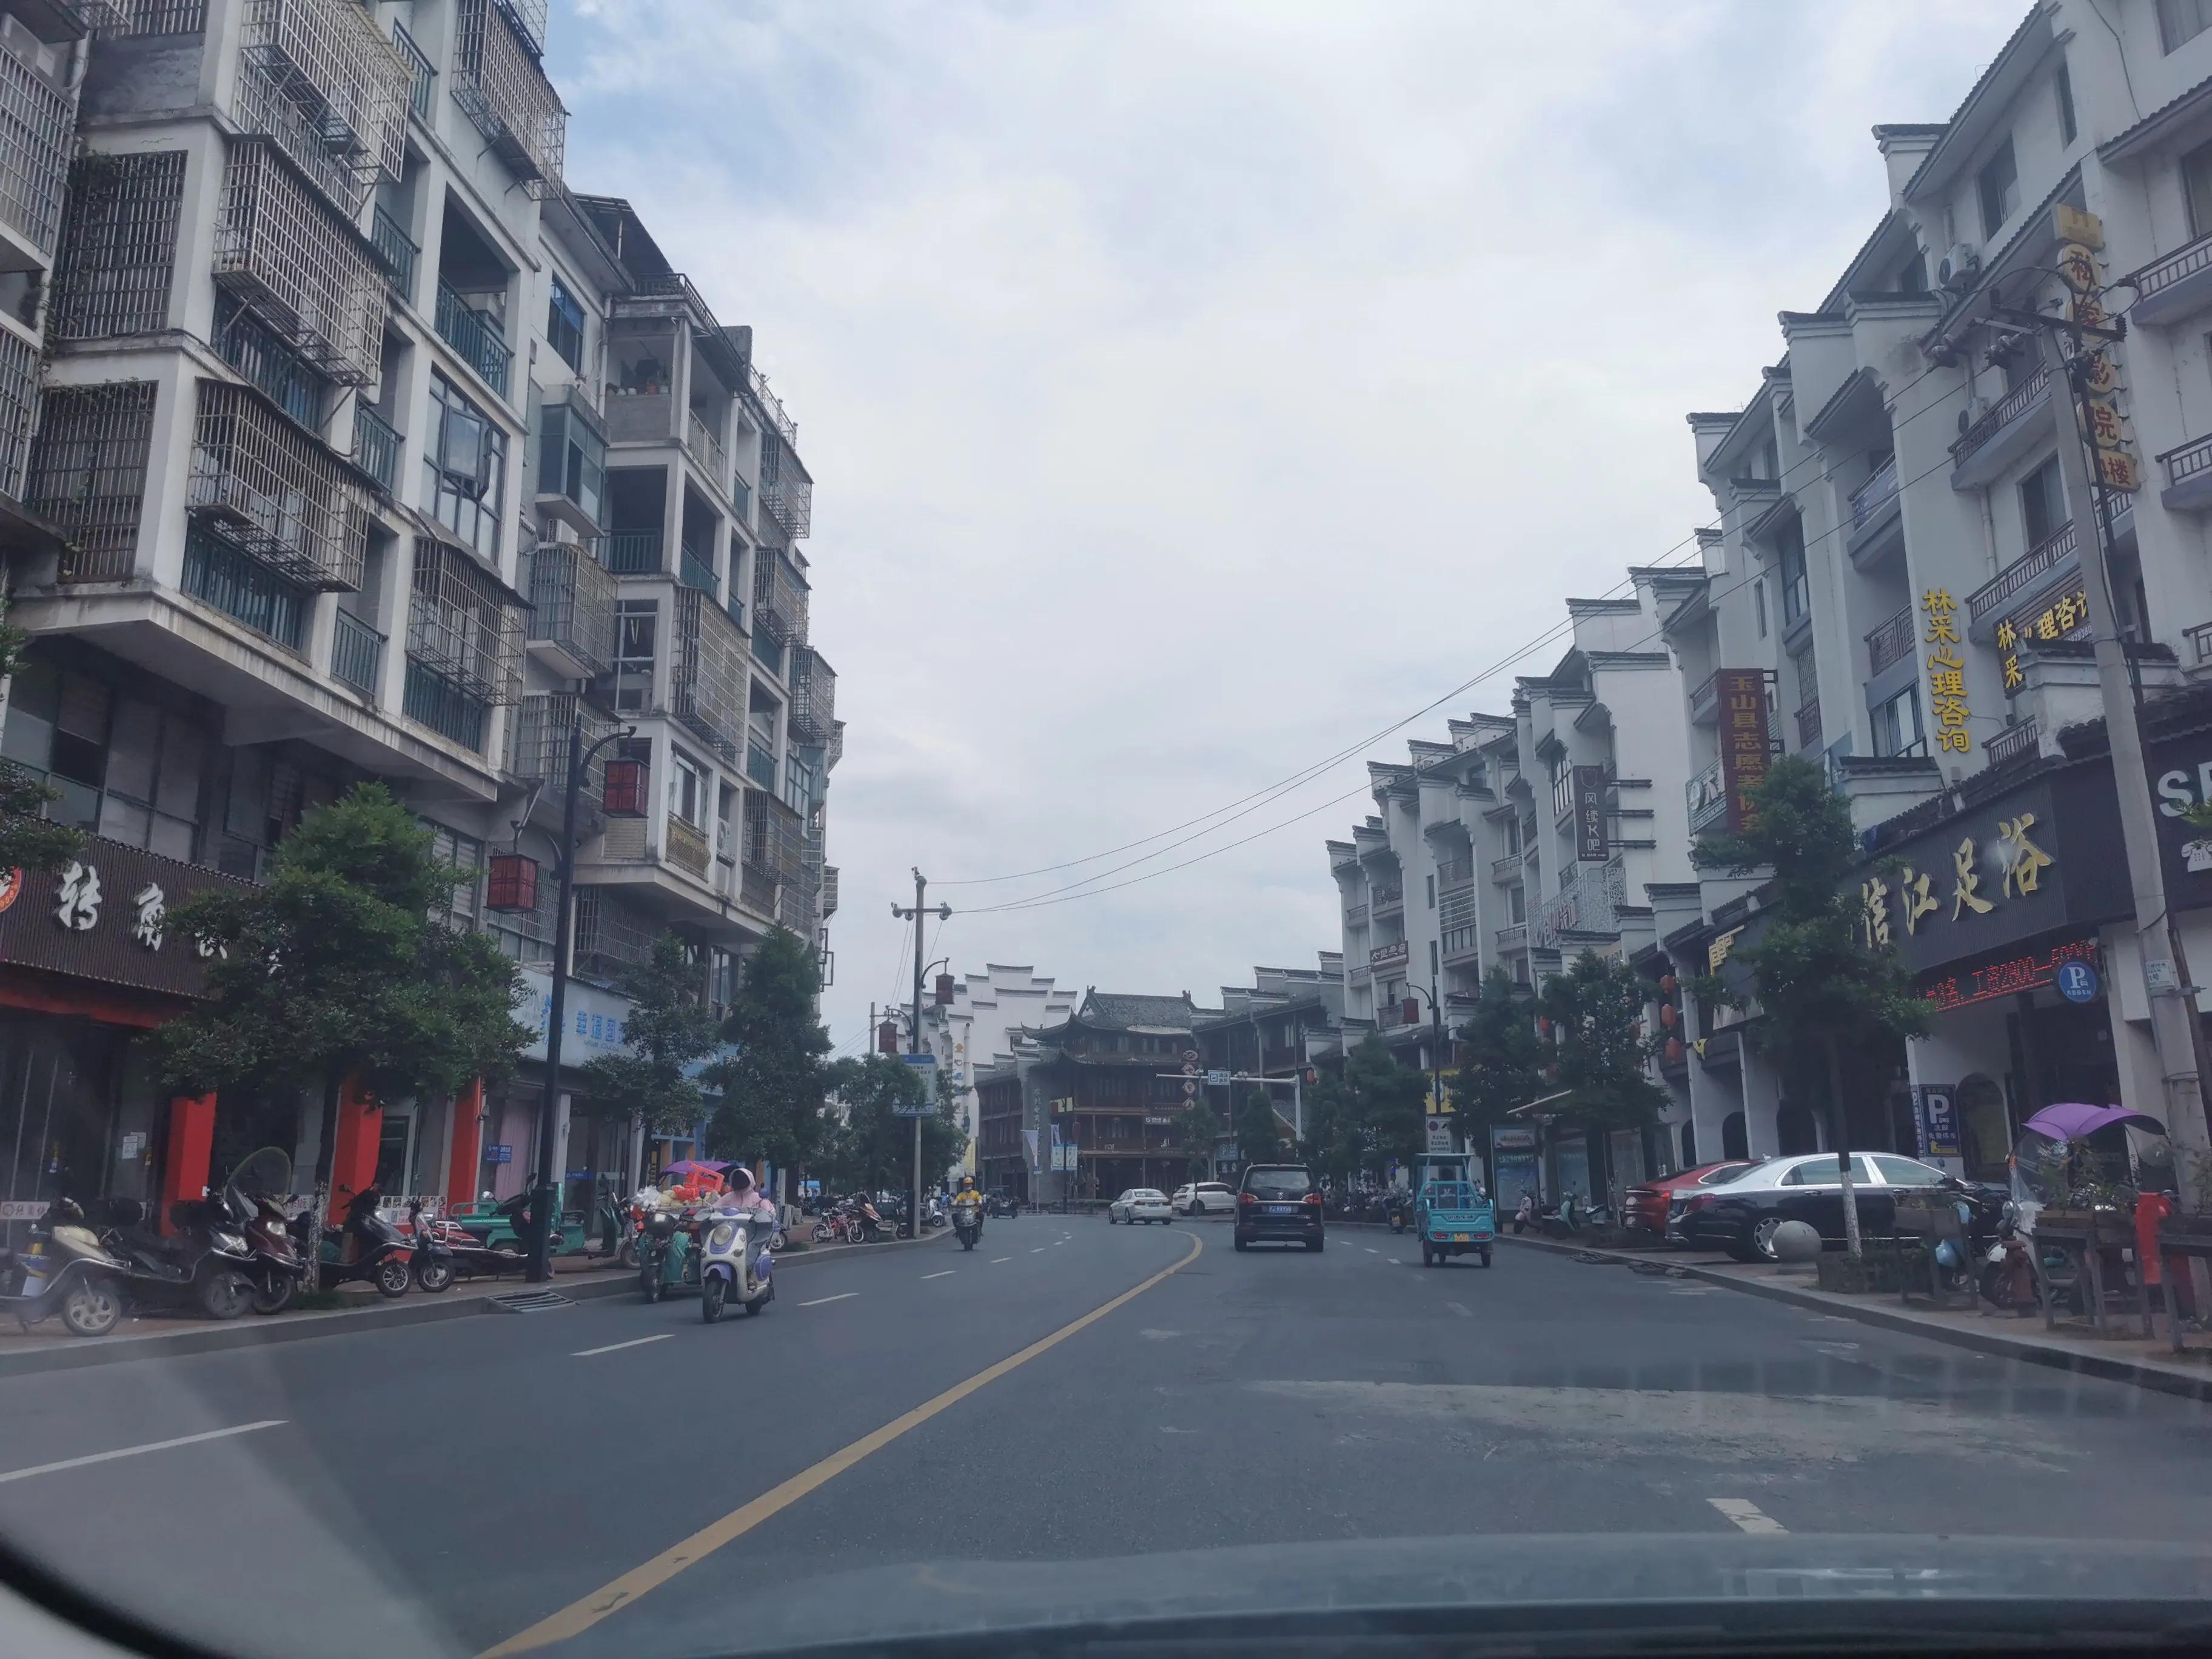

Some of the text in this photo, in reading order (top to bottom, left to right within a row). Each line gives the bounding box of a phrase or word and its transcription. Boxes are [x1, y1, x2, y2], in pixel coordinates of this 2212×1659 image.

[1922, 588, 1970, 752] 林采心理咨询
[2067, 967, 2085, 988] P
[1927, 1094, 1949, 1124] P
